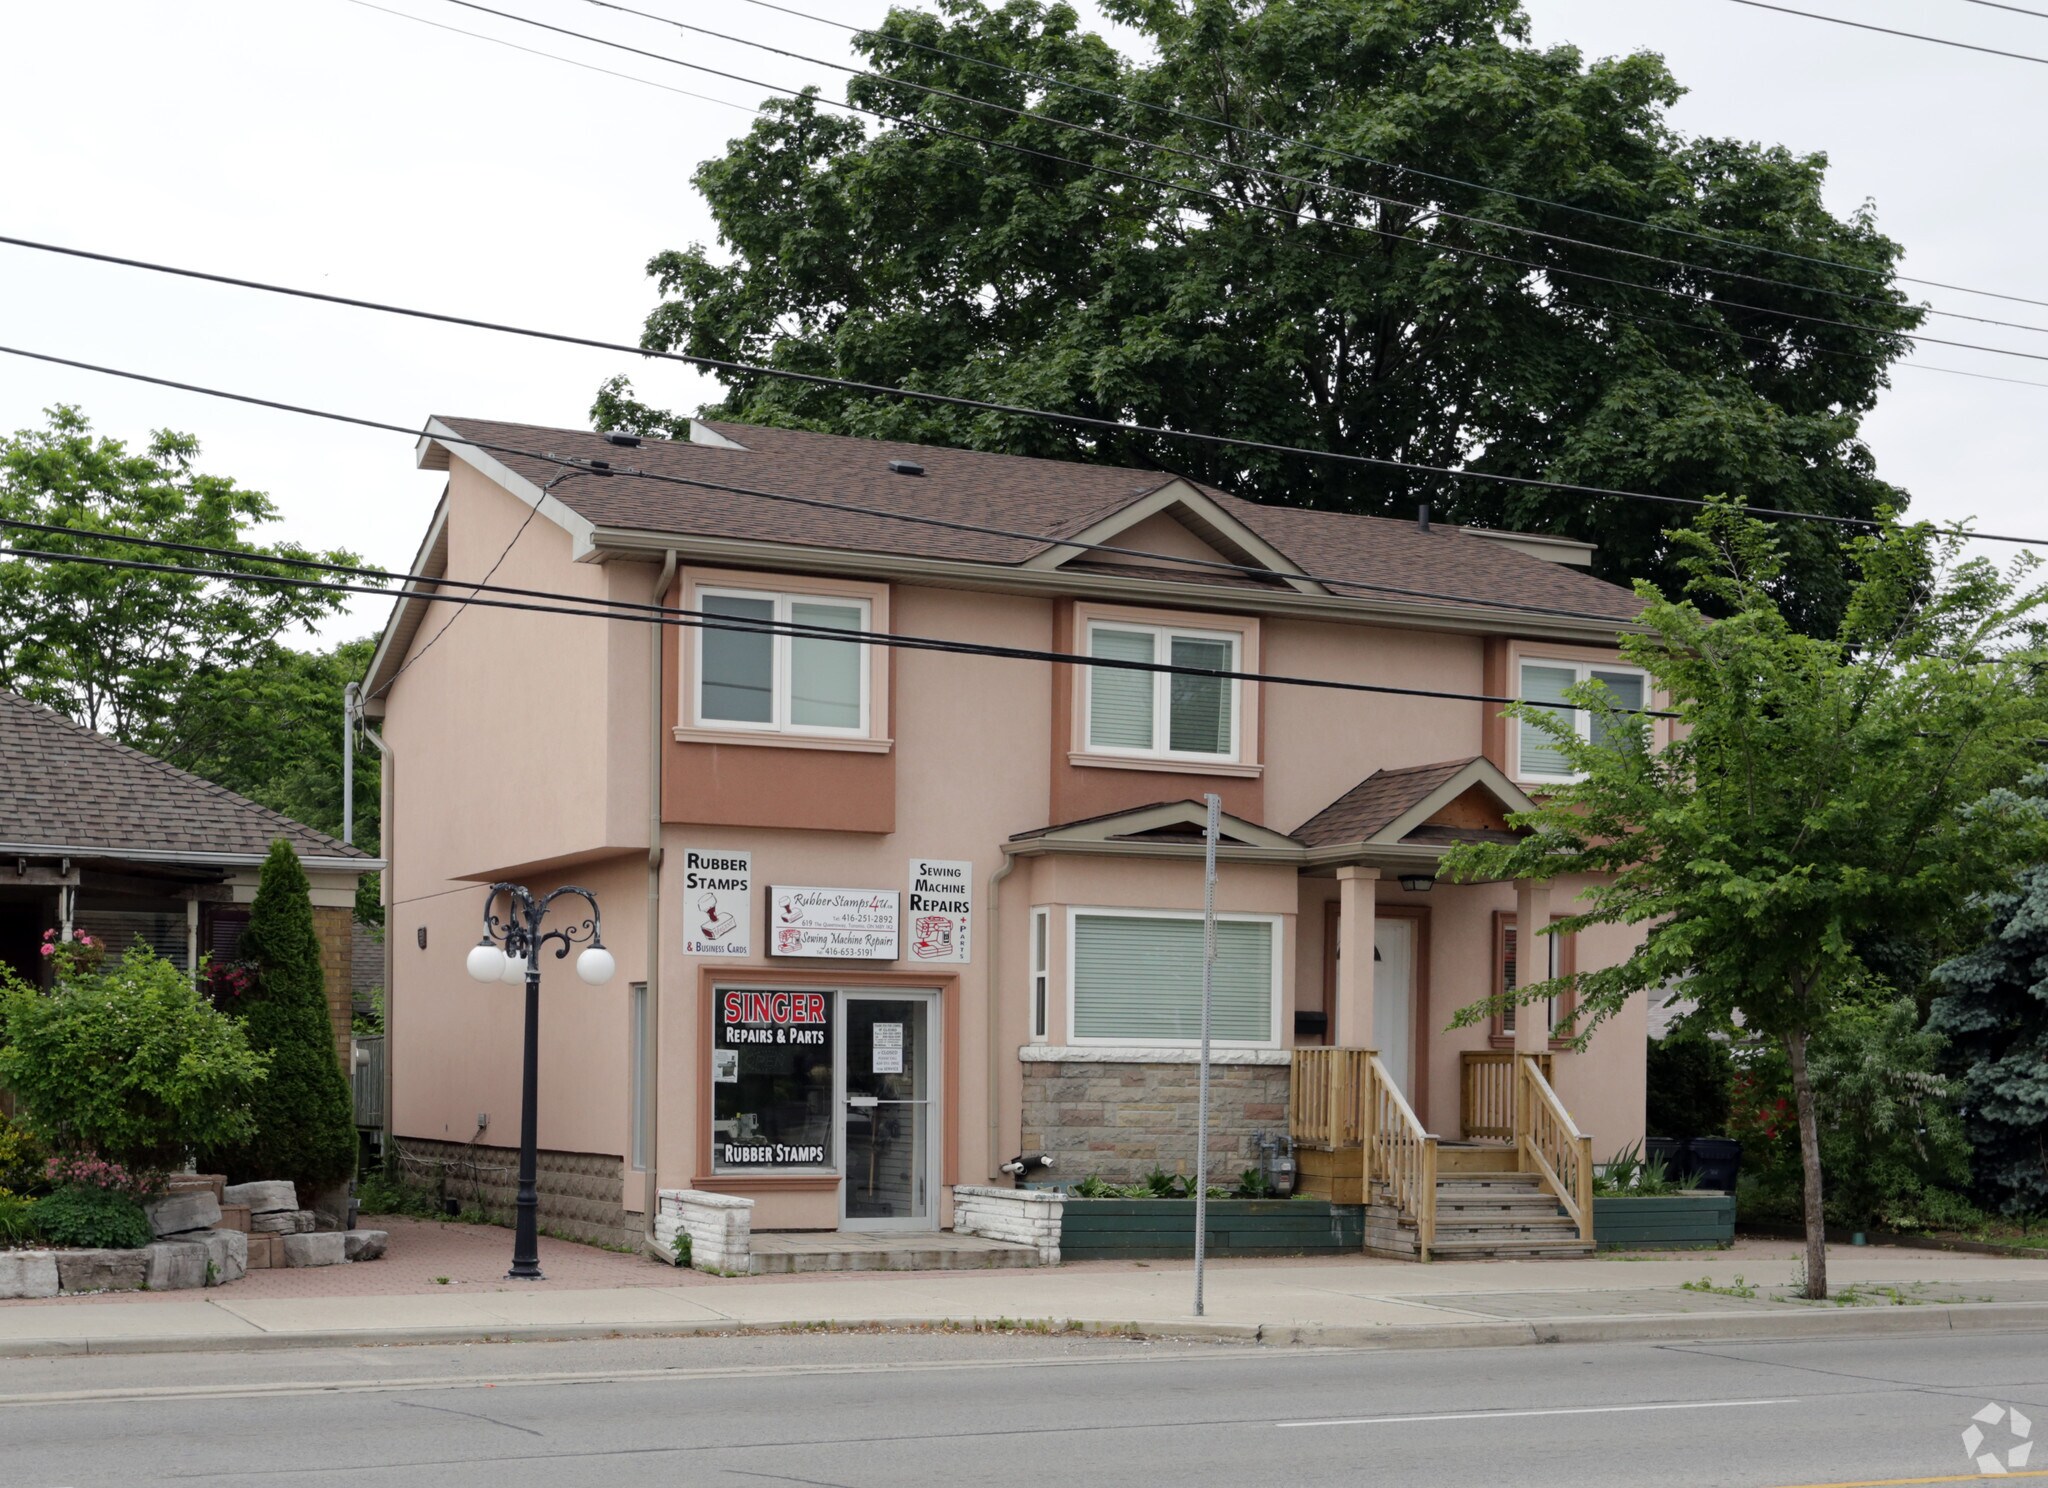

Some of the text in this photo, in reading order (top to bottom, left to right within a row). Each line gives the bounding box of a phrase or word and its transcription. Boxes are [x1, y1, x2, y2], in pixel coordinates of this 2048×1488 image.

[687, 852, 748, 871] RUBBER
[919, 863, 962, 878] SEWING
[686, 872, 748, 891] STAMPS
[914, 879, 966, 894] MACHINE
[909, 893, 970, 914] REPAIRS
[841, 914, 893, 924] 416-251-2892
[687, 941, 748, 954] & BUSINESS CARDS
[801, 931, 894, 951] Sewing Machine Repairs
[825, 947, 873, 956] 416-653-5191
[724, 991, 827, 1024] SINGER
[726, 1026, 825, 1045] REPAIRS & PARTS
[725, 1143, 824, 1163] RUBBER STAMPS
